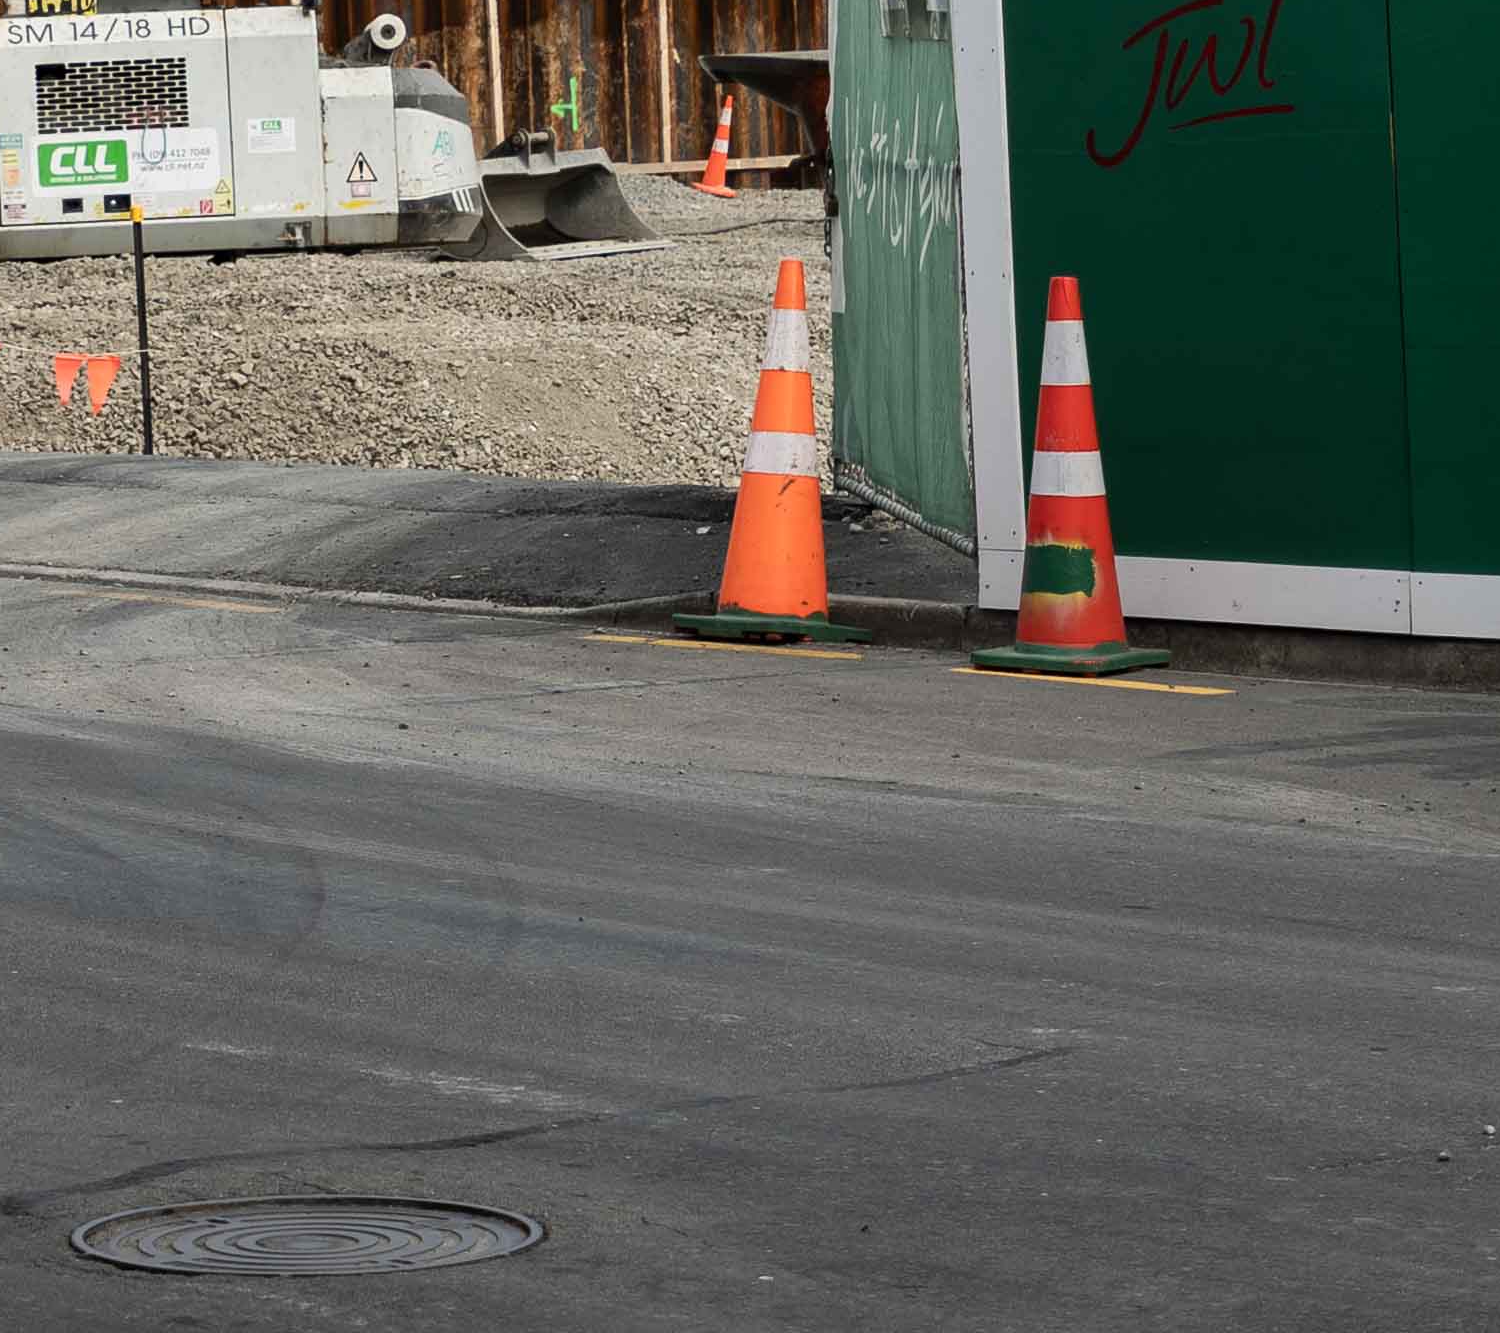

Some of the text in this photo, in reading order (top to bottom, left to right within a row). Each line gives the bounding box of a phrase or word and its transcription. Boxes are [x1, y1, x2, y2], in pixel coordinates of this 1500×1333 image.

[7, 23, 54, 45] SM
[168, 16, 211, 37] HD
[50, 144, 117, 175] CLL
